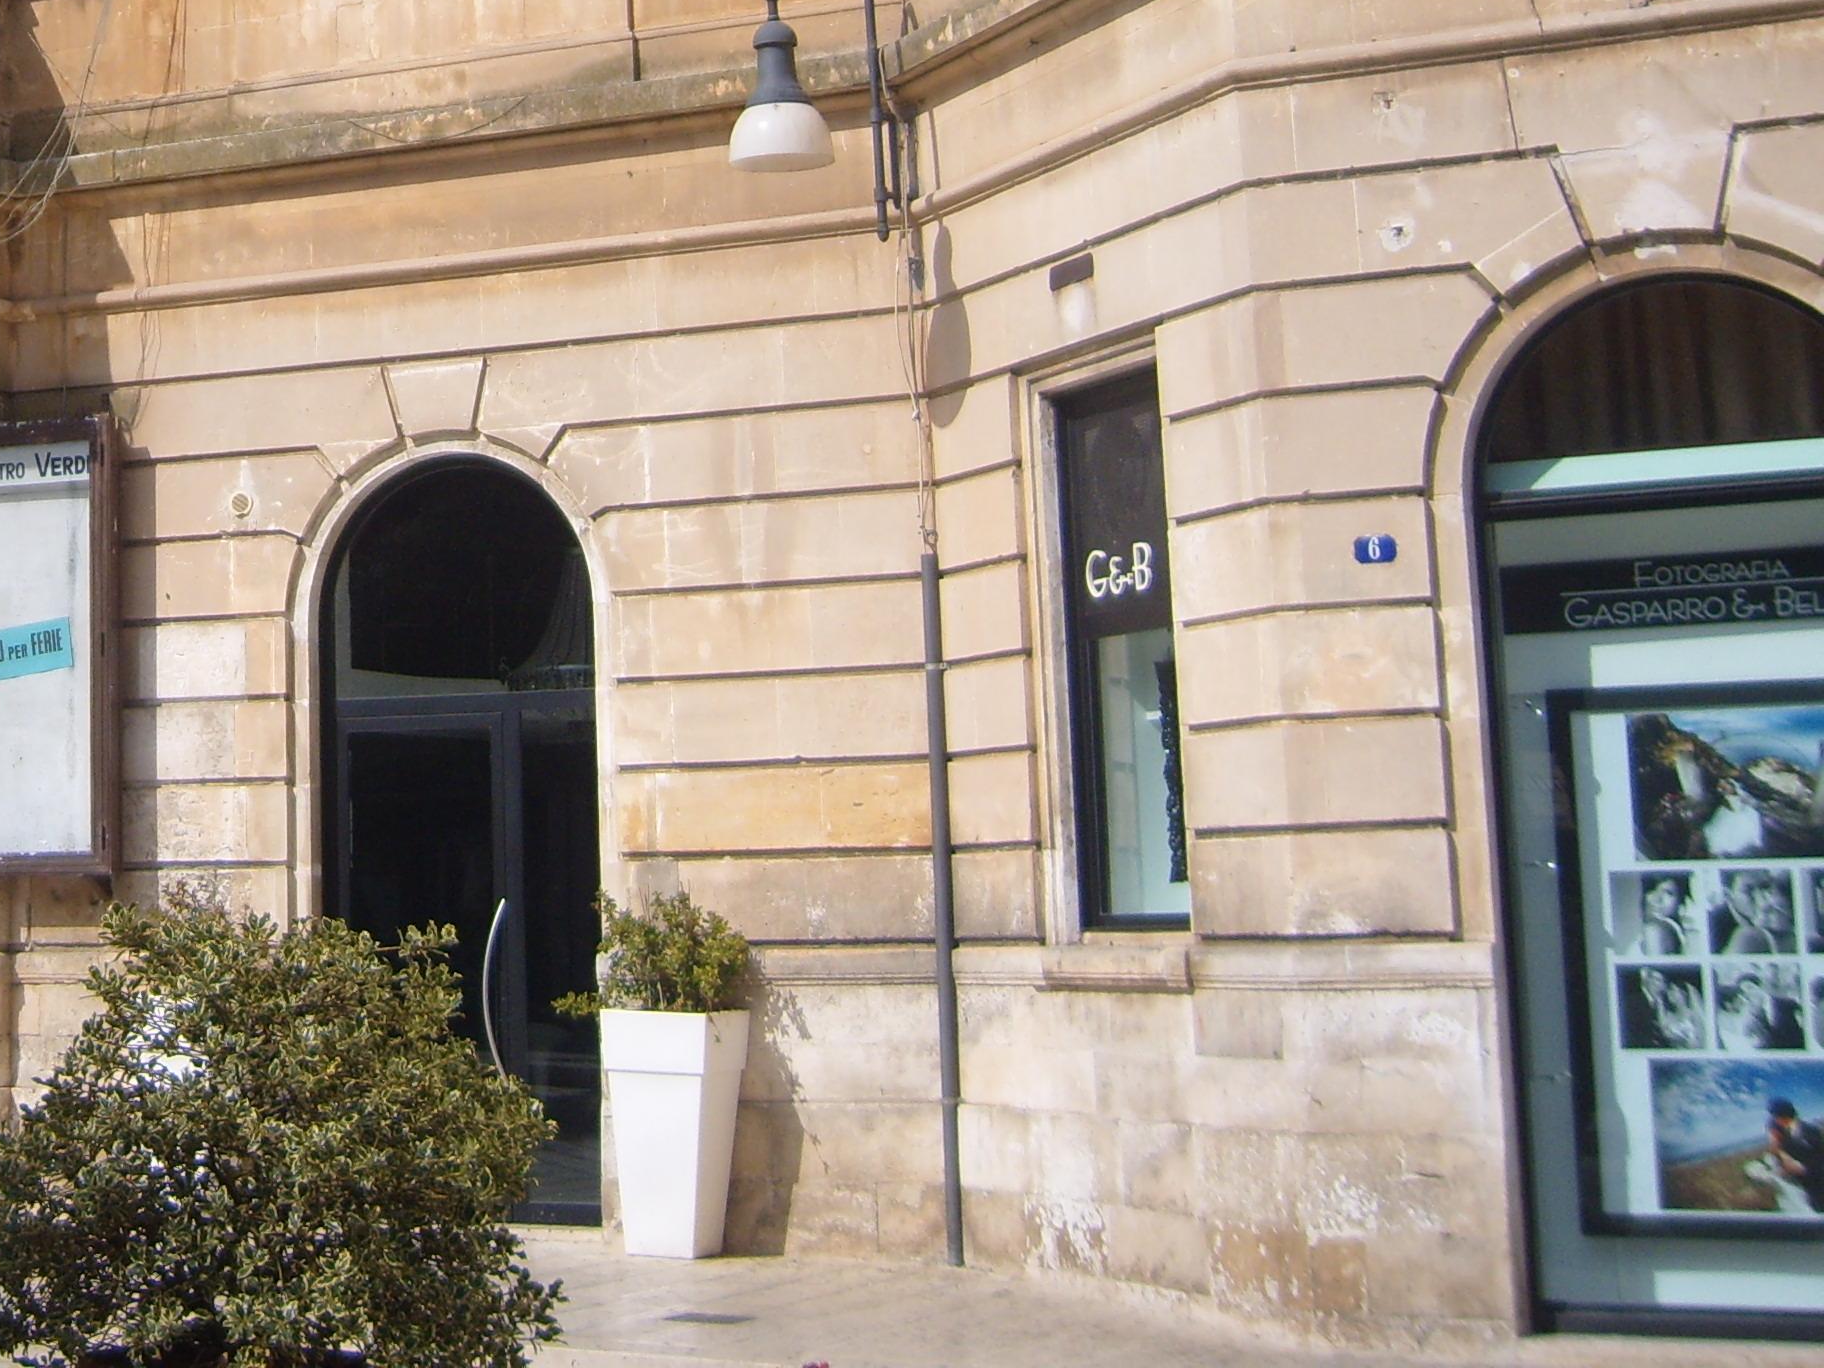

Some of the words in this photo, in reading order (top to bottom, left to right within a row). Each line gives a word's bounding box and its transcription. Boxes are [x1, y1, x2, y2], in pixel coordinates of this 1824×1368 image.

[1368, 535, 1381, 560] 6
[1085, 541, 1153, 599] G&B
[1633, 559, 1791, 589] FOTOGRAFIA
[1564, 596, 1727, 629] GASPARRO
[1732, 588, 1767, 619] &
[7, 643, 28, 661] PER
[30, 628, 63, 656] FERIE
